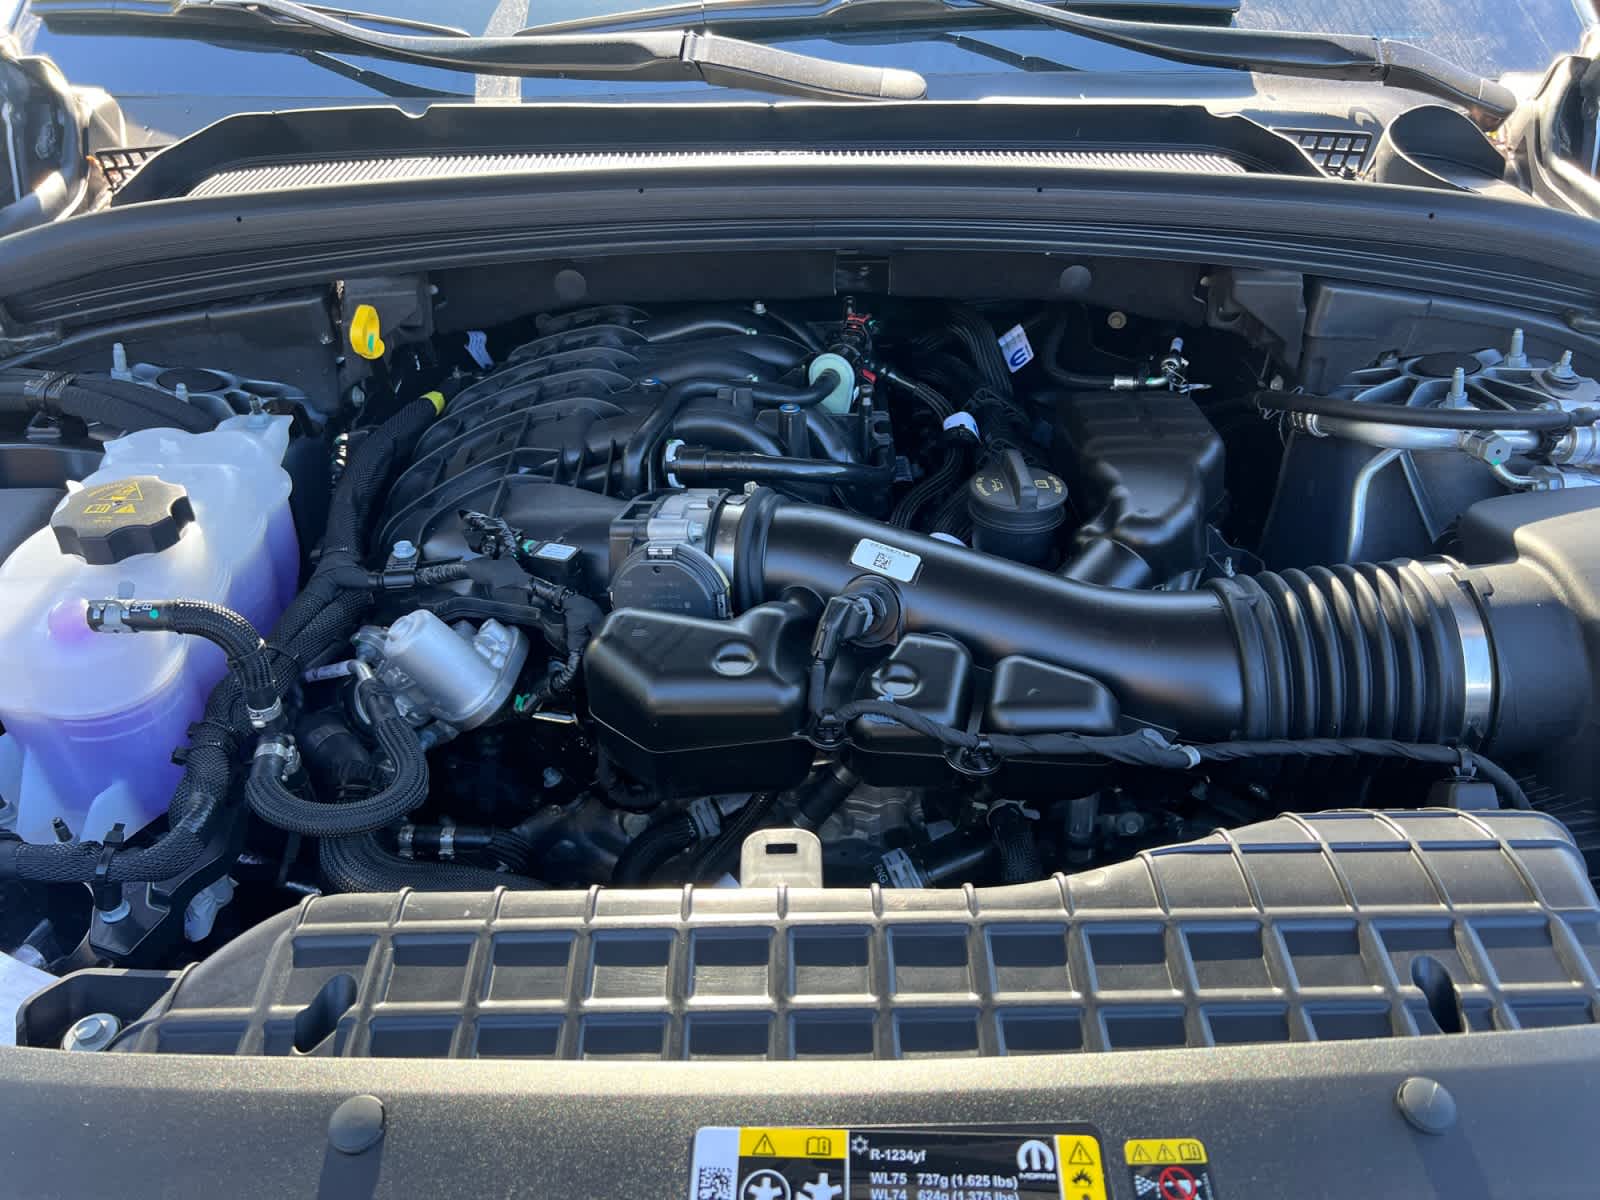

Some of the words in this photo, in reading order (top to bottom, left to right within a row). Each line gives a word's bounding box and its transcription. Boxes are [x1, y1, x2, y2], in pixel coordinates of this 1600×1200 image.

[870, 1148, 927, 1164] R-1234yf
[870, 1172, 907, 1184] WL75
[917, 1173, 949, 1188] 737g
[951, 1174, 991, 1188] (1.625
[992, 1175, 1018, 1190] lbs)
